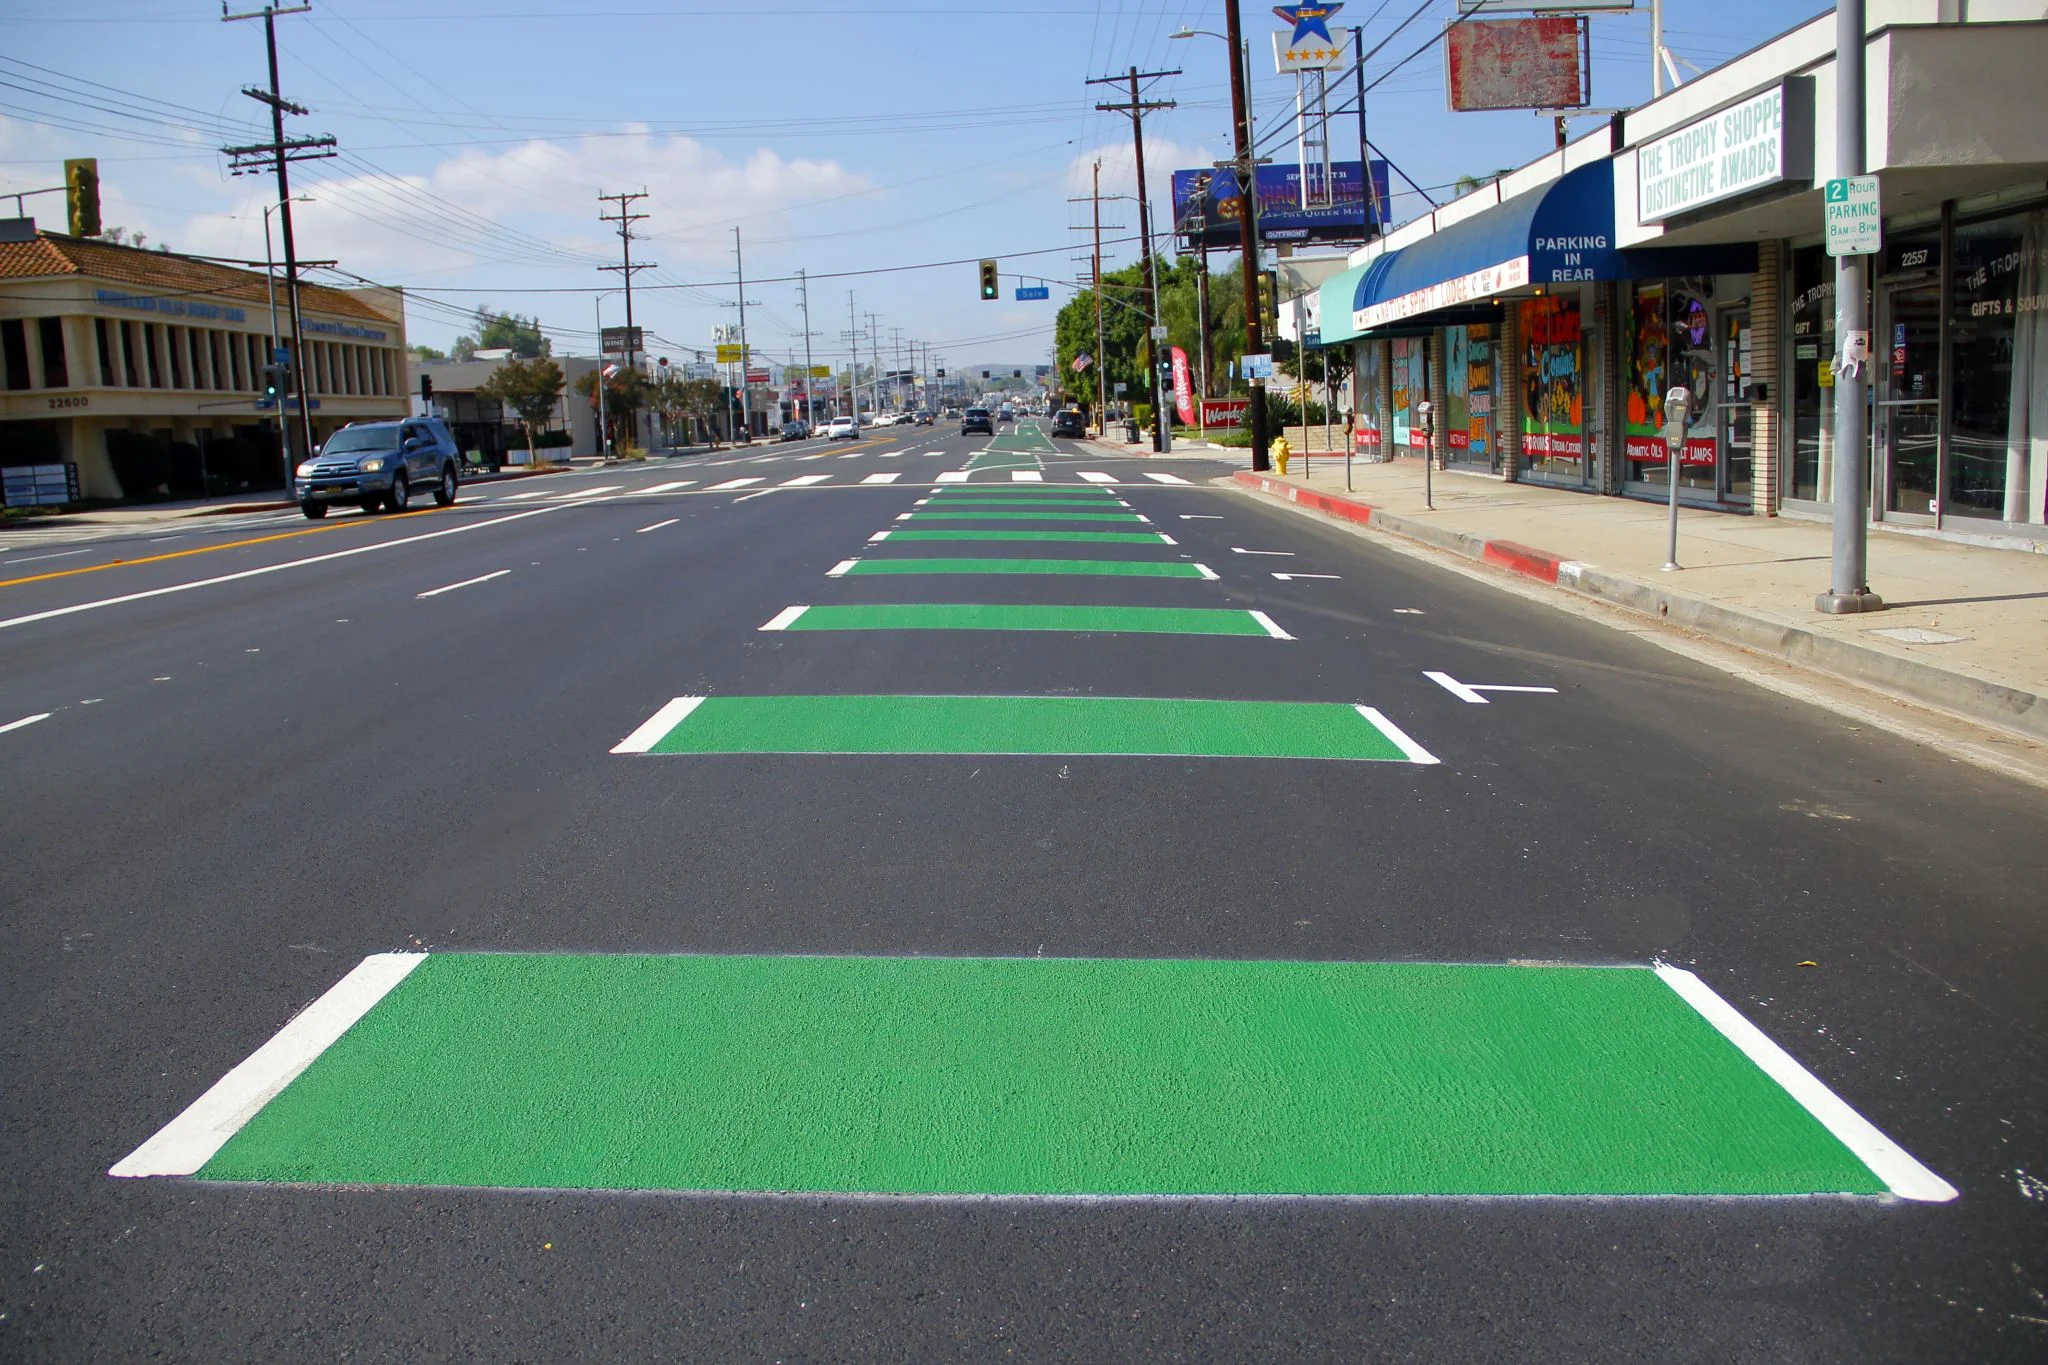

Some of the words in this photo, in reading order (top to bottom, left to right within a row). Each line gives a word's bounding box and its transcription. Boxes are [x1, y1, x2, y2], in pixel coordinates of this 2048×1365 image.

[1641, 145, 1662, 180] THE
[1667, 119, 1718, 170] TROPHY
[1724, 92, 1781, 149] SHOPPE
[1646, 160, 1714, 214] DISTINCTIVE
[1720, 136, 1776, 189] AWARDS
[1831, 182, 1842, 200] 2
[1849, 181, 1876, 194] HOUR
[1305, 209, 1339, 218] QUEEN
[1343, 207, 1364, 216] MAR
[1829, 201, 1877, 219] PARKING
[1267, 230, 1306, 239] OUTFRONT
[1830, 224, 1849, 237] 8AM
[1858, 222, 1877, 234] 8PM
[1535, 235, 1607, 251] PARKING
[1564, 252, 1581, 266] IN
[1902, 249, 1928, 267] 22557
[1552, 268, 1594, 282] REAR
[1966, 265, 1988, 293] THE
[1990, 247, 2036, 277] TROPHY
[1023, 290, 1043, 298] Sale
[1380, 294, 1407, 323] NATIVE
[1409, 285, 1436, 315] SPIRIT
[1440, 276, 1468, 306] LODGE
[1791, 294, 1806, 315] THE
[1807, 281, 1836, 304] TROPHY
[1971, 300, 2001, 317] GIFTS
[2005, 298, 2012, 313] &
[1795, 321, 1810, 335] GIFT
[604, 339, 625, 347] WINE
[48, 396, 89, 409] 22600
[1205, 404, 1246, 424] Wendy
[1528, 435, 1549, 451] DRUMS
[1627, 443, 1650, 457] AROMATIC
[1650, 443, 1663, 458] OILS
[1690, 446, 1713, 463] LAMPS
